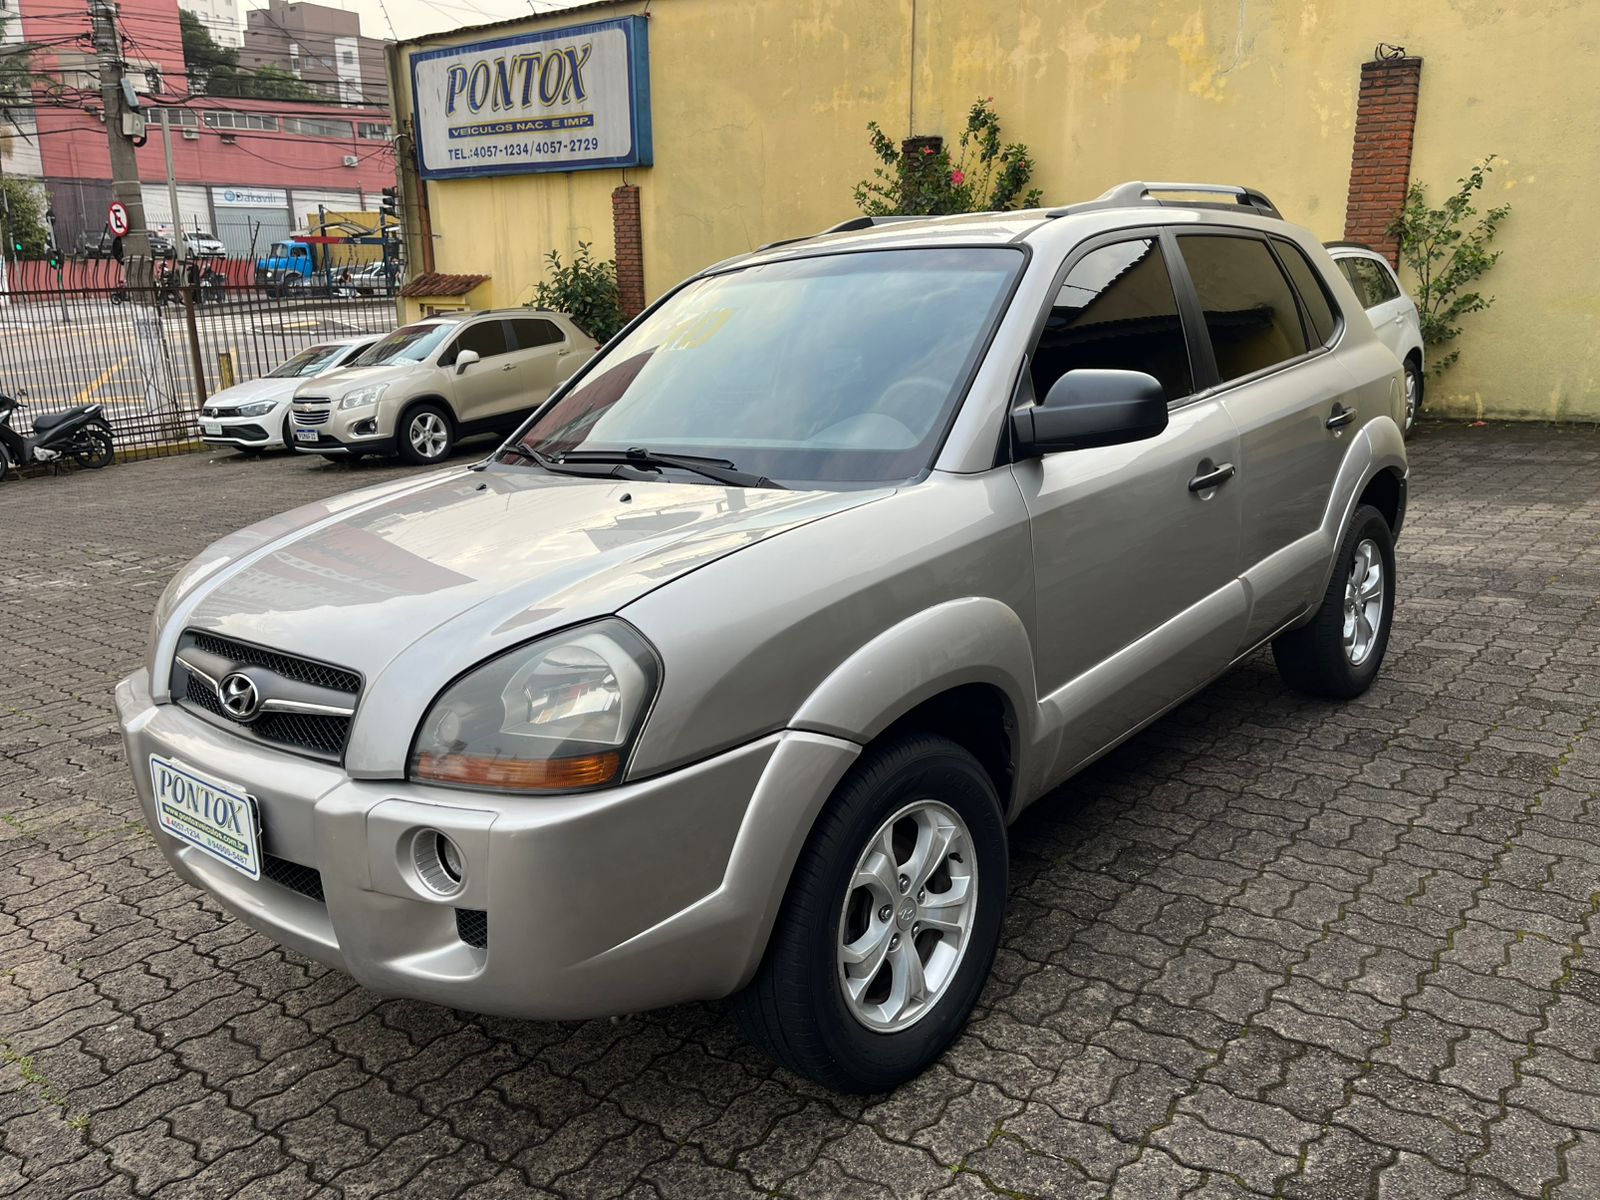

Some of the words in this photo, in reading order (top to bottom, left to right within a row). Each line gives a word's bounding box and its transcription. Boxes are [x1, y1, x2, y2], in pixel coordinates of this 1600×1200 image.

[446, 43, 592, 117] PONTOX
[516, 120, 548, 131] NAC.
[551, 119, 561, 128] E
[564, 116, 591, 127] IMP.
[160, 768, 243, 836] PONTOX
